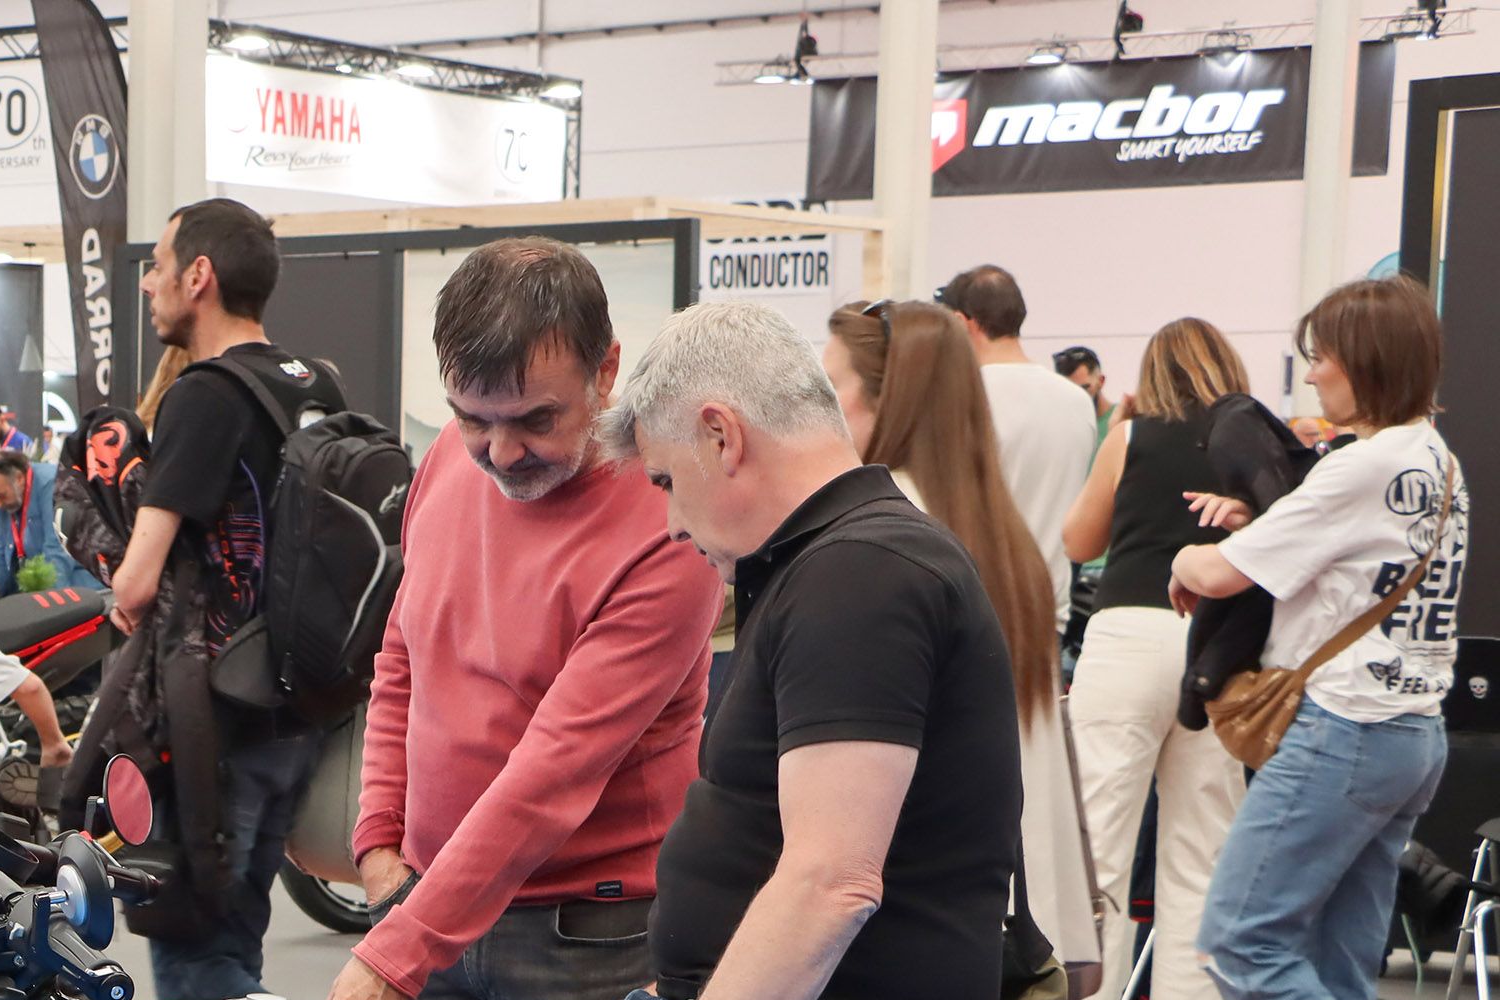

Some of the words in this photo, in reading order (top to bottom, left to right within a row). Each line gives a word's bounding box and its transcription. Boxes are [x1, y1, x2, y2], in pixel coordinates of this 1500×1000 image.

[257, 88, 361, 143] YAMAHA
[972, 84, 1285, 147] macbor
[245, 146, 287, 167] Revs
[287, 150, 318, 171] Your
[1116, 138, 1175, 162] SMART
[710, 251, 829, 289] CONDUCTOR
